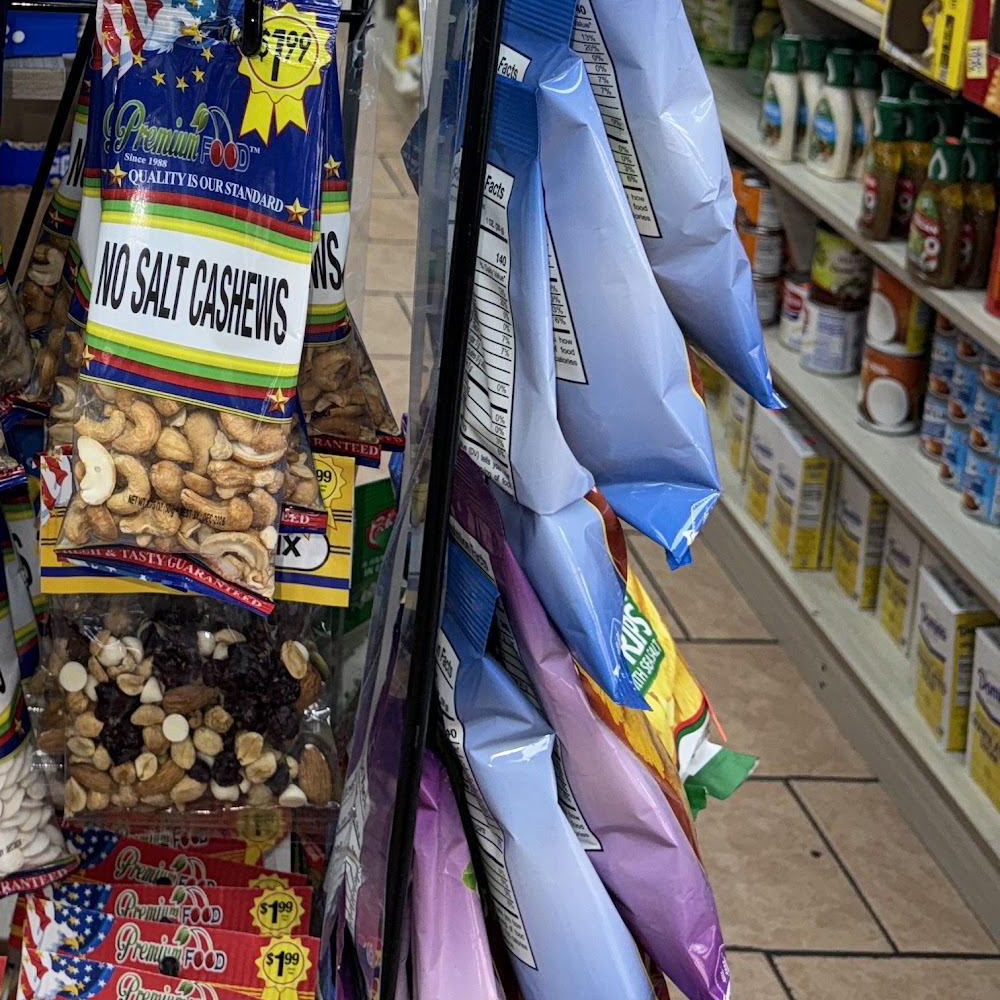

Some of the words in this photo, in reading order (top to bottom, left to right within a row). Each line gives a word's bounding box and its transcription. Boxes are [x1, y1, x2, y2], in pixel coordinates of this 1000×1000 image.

[497, 57, 519, 80] Facts
[113, 99, 200, 162] Premium
[200, 135, 251, 173] FOOD
[124, 152, 146, 164] Since
[147, 156, 168, 169] 1988
[128, 168, 186, 187] QUALITY
[187, 171, 199, 188] IS
[199, 174, 223, 194] OUR
[224, 179, 285, 215] STANDARD
[484, 175, 506, 200] Facts
[95, 240, 130, 311] NO
[130, 246, 190, 322] SALT
[188, 258, 290, 346] CASHEWS
[118, 549, 167, 567] TASTY
[167, 556, 263, 608] GUARANTEED
[182, 906, 223, 925] FOOD
[115, 922, 183, 964] Premium
[184, 949, 227, 972] FOOD
